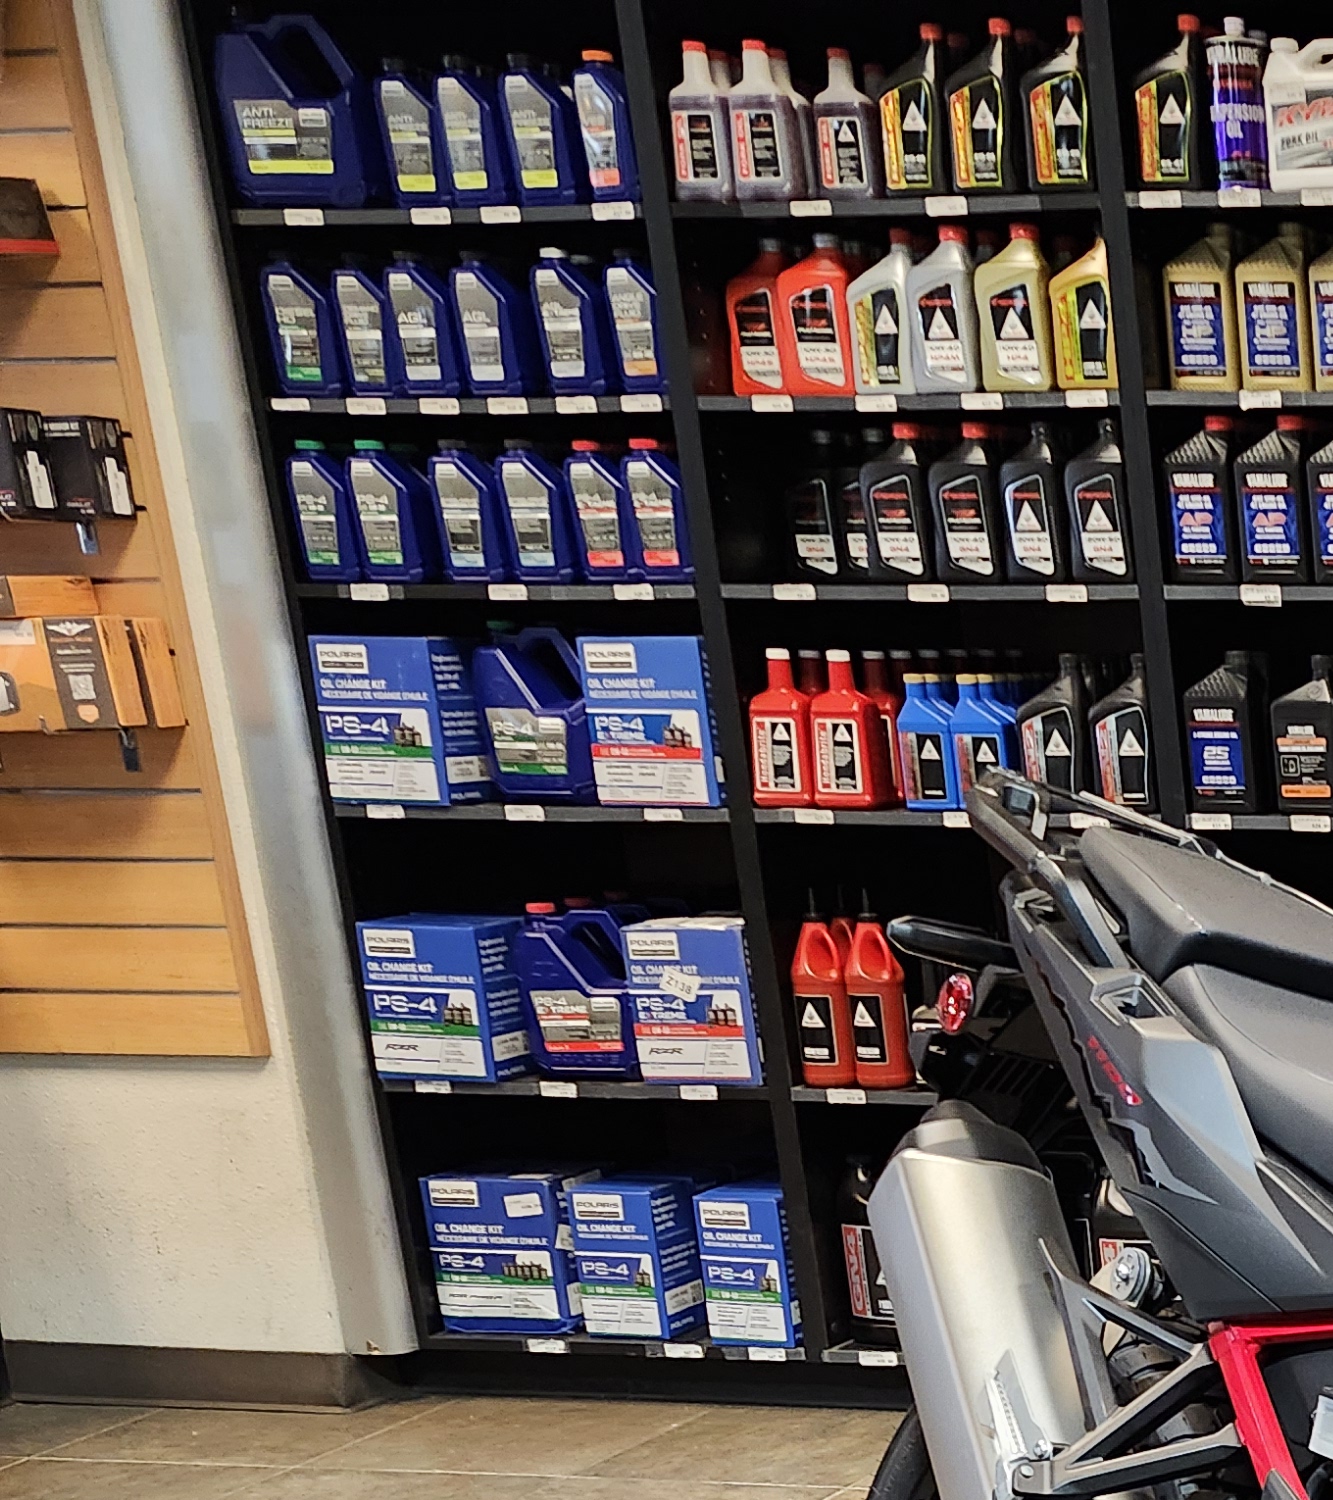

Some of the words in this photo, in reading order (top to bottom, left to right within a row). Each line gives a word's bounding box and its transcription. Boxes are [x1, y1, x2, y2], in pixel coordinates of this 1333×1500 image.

[243, 117, 294, 129] FREEZE
[397, 311, 428, 324] AGL
[462, 311, 491, 323] AGL
[320, 651, 364, 659] POLARIS
[587, 650, 632, 658] POLARIS
[320, 679, 334, 689] OIL
[335, 679, 371, 690] CHANGE
[371, 680, 388, 690] KIT
[587, 678, 602, 689] OIL
[602, 678, 639, 690] CHANGE
[640, 678, 656, 689] KIT
[325, 715, 390, 735] PS-4
[492, 721, 535, 736] PS-4
[594, 716, 645, 731] PS-4
[366, 936, 410, 944] POLARIS
[629, 939, 675, 947] POLARIS
[366, 961, 382, 972] OIL
[382, 962, 418, 973] CHANGE
[418, 963, 434, 973] KIT
[630, 965, 646, 975] OIL
[682, 966, 698, 975] KIT
[664, 976, 693, 995] Z138
[373, 993, 438, 1014] PS-4
[534, 996, 567, 1006] PS-4
[635, 997, 687, 1011] PS-4
[537, 1005, 588, 1014] EXTREME
[638, 1011, 687, 1020] EXTREME
[385, 1043, 419, 1052] RZR
[648, 1047, 684, 1055] RZR
[430, 1187, 475, 1195] POLARIS
[576, 1201, 620, 1209] POLARIS
[702, 1209, 747, 1217] POLARIS
[434, 1223, 450, 1233] OIL
[450, 1223, 488, 1234] CHANGE
[488, 1224, 505, 1235] KIT
[576, 1224, 591, 1233] OIL
[590, 1224, 623, 1233] CHANGE
[623, 1224, 637, 1234] KIT
[703, 1232, 717, 1240] OIL
[716, 1233, 749, 1242] CHANGE
[749, 1234, 763, 1243] KIT
[438, 1254, 486, 1268] PS-4
[581, 1261, 630, 1276] PS-4
[707, 1266, 756, 1281] PS-4
